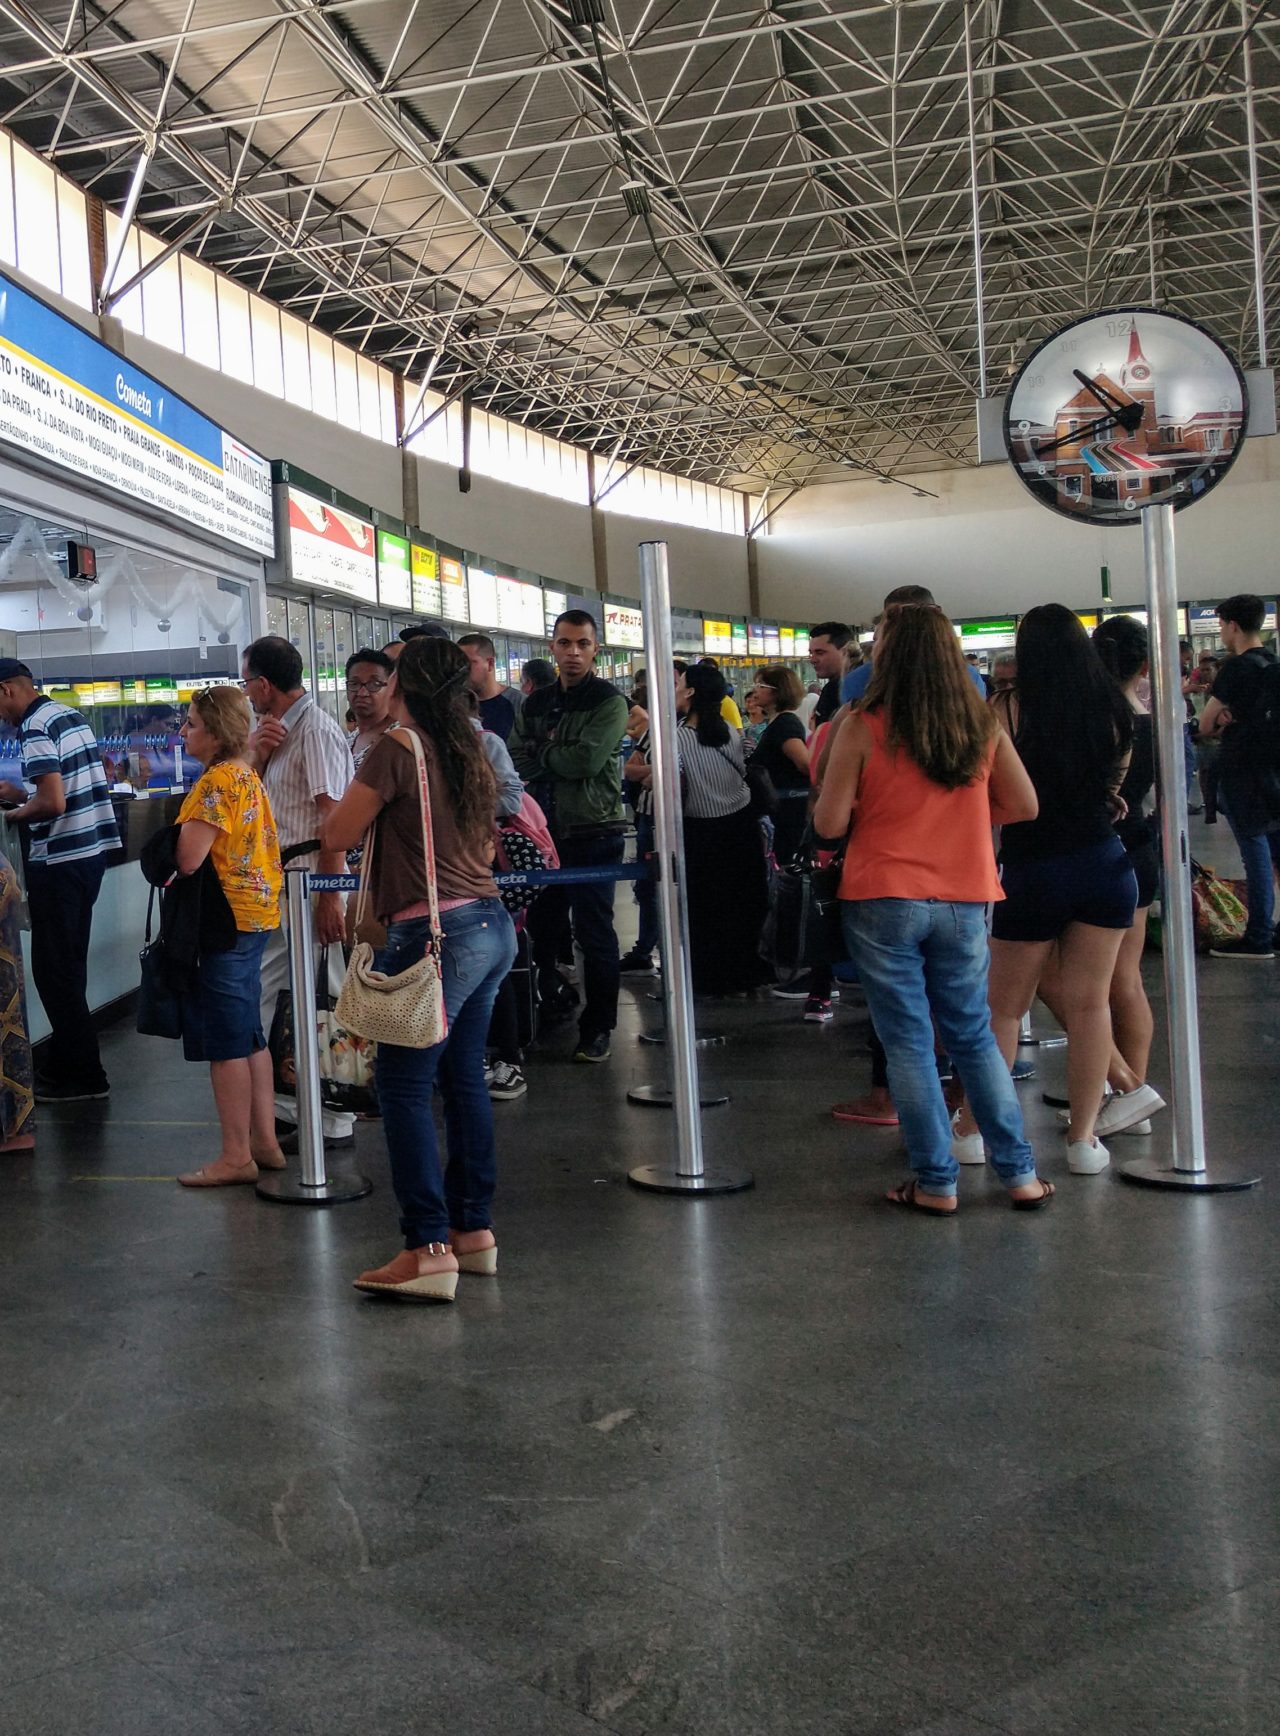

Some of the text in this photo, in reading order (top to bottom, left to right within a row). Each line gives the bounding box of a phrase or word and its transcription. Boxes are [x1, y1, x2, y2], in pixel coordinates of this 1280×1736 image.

[1104, 319, 1135, 338] 12
[2, 388, 11, 407] DA
[12, 393, 31, 417] PRATA
[116, 373, 152, 417] Cometa
[1220, 395, 1233, 412] 3
[20, 365, 51, 397] FRANCA
[59, 387, 66, 406] S.
[68, 392, 74, 410] J.
[75, 396, 84, 416] DO
[85, 402, 96, 422] RIO
[97, 409, 117, 434] PRETO
[123, 424, 139, 446] PRAIA
[140, 433, 160, 458] GRANDE
[165, 448, 183, 471] SANTOS
[1018, 420, 1031, 436] 9
[1037, 464, 1047, 476] 8
[1176, 481, 1186, 493] 5
[1124, 496, 1137, 511] 6
[309, 876, 356, 889] ometa
